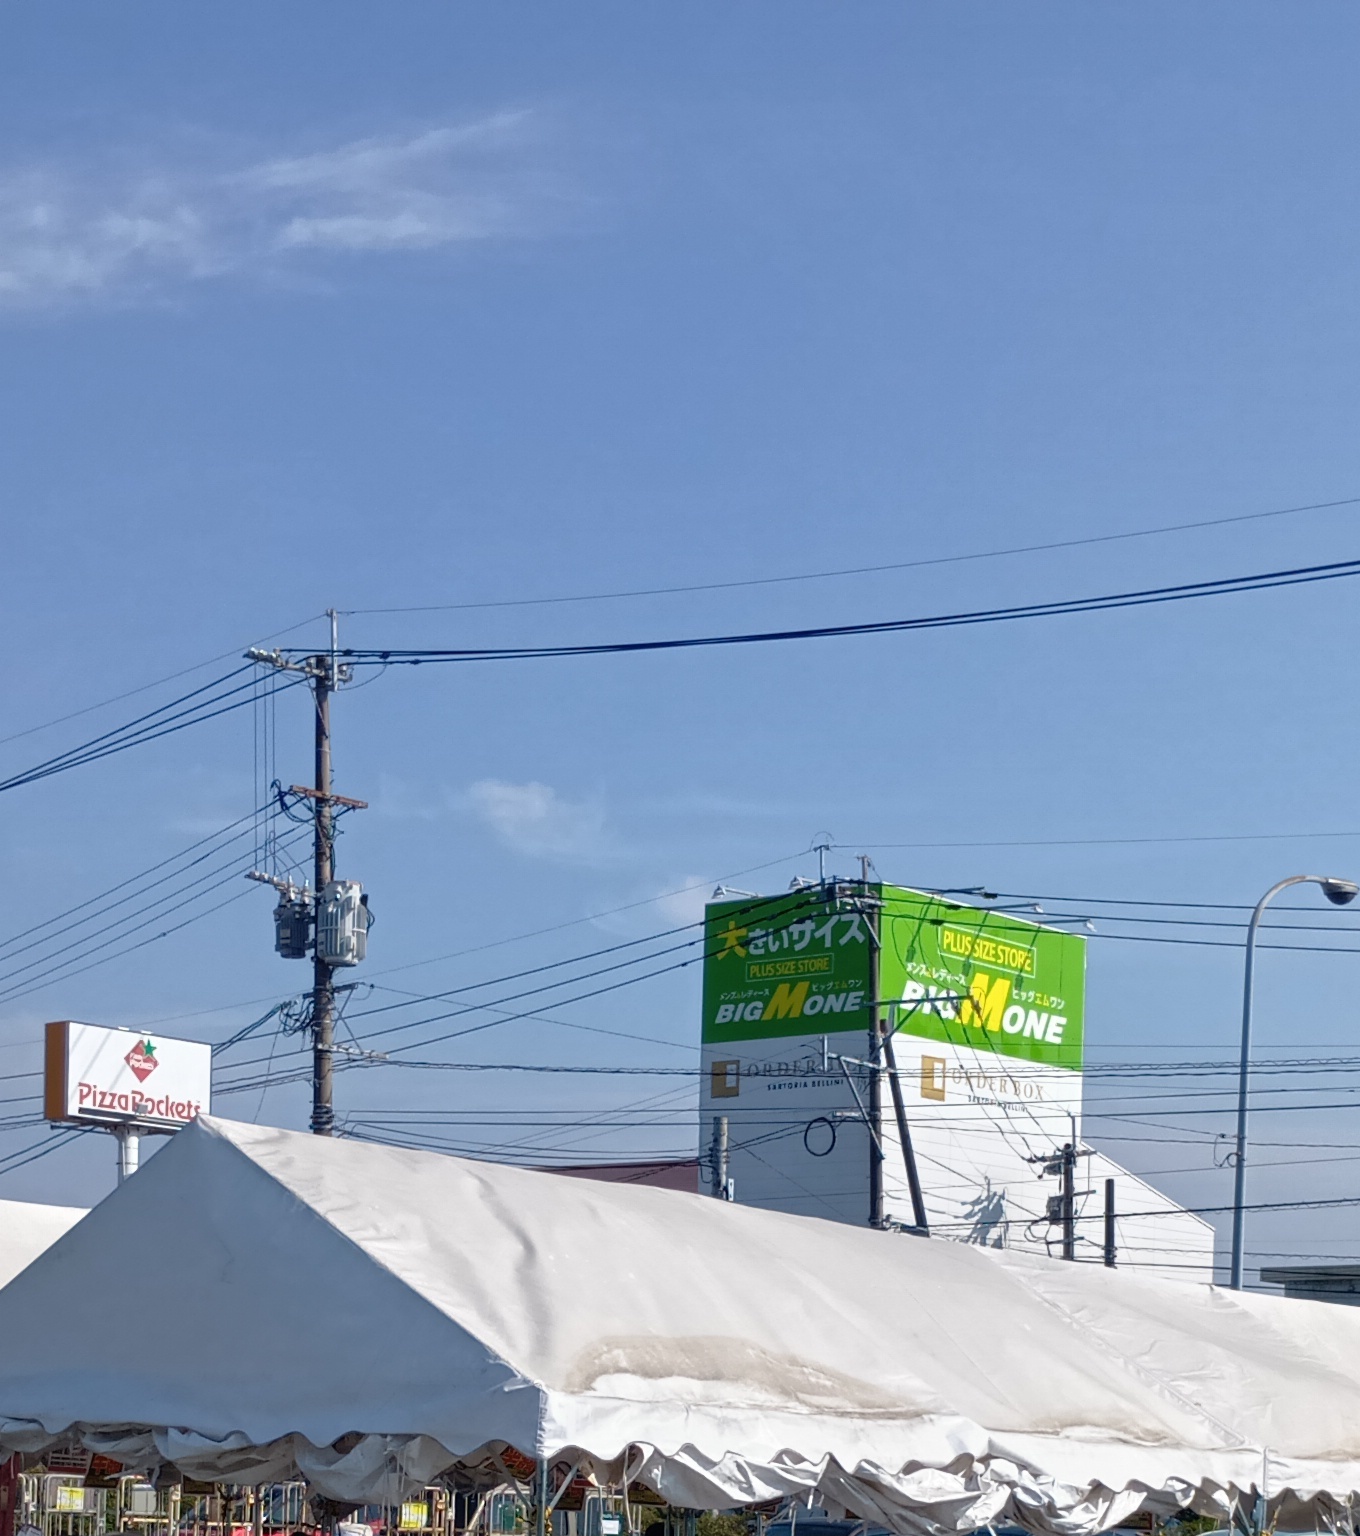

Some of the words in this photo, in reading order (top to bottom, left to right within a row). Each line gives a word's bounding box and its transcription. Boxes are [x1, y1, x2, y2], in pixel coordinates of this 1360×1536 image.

[943, 930, 973, 955] PLUS
[973, 939, 996, 964] SIZE
[997, 945, 1032, 972] STORE
[749, 965, 775, 978] PLUS
[776, 961, 796, 975] SIZE
[797, 957, 830, 973] STORE
[767, 1081, 808, 1091] SARTORIA
[811, 1079, 844, 1088] BELLINI
